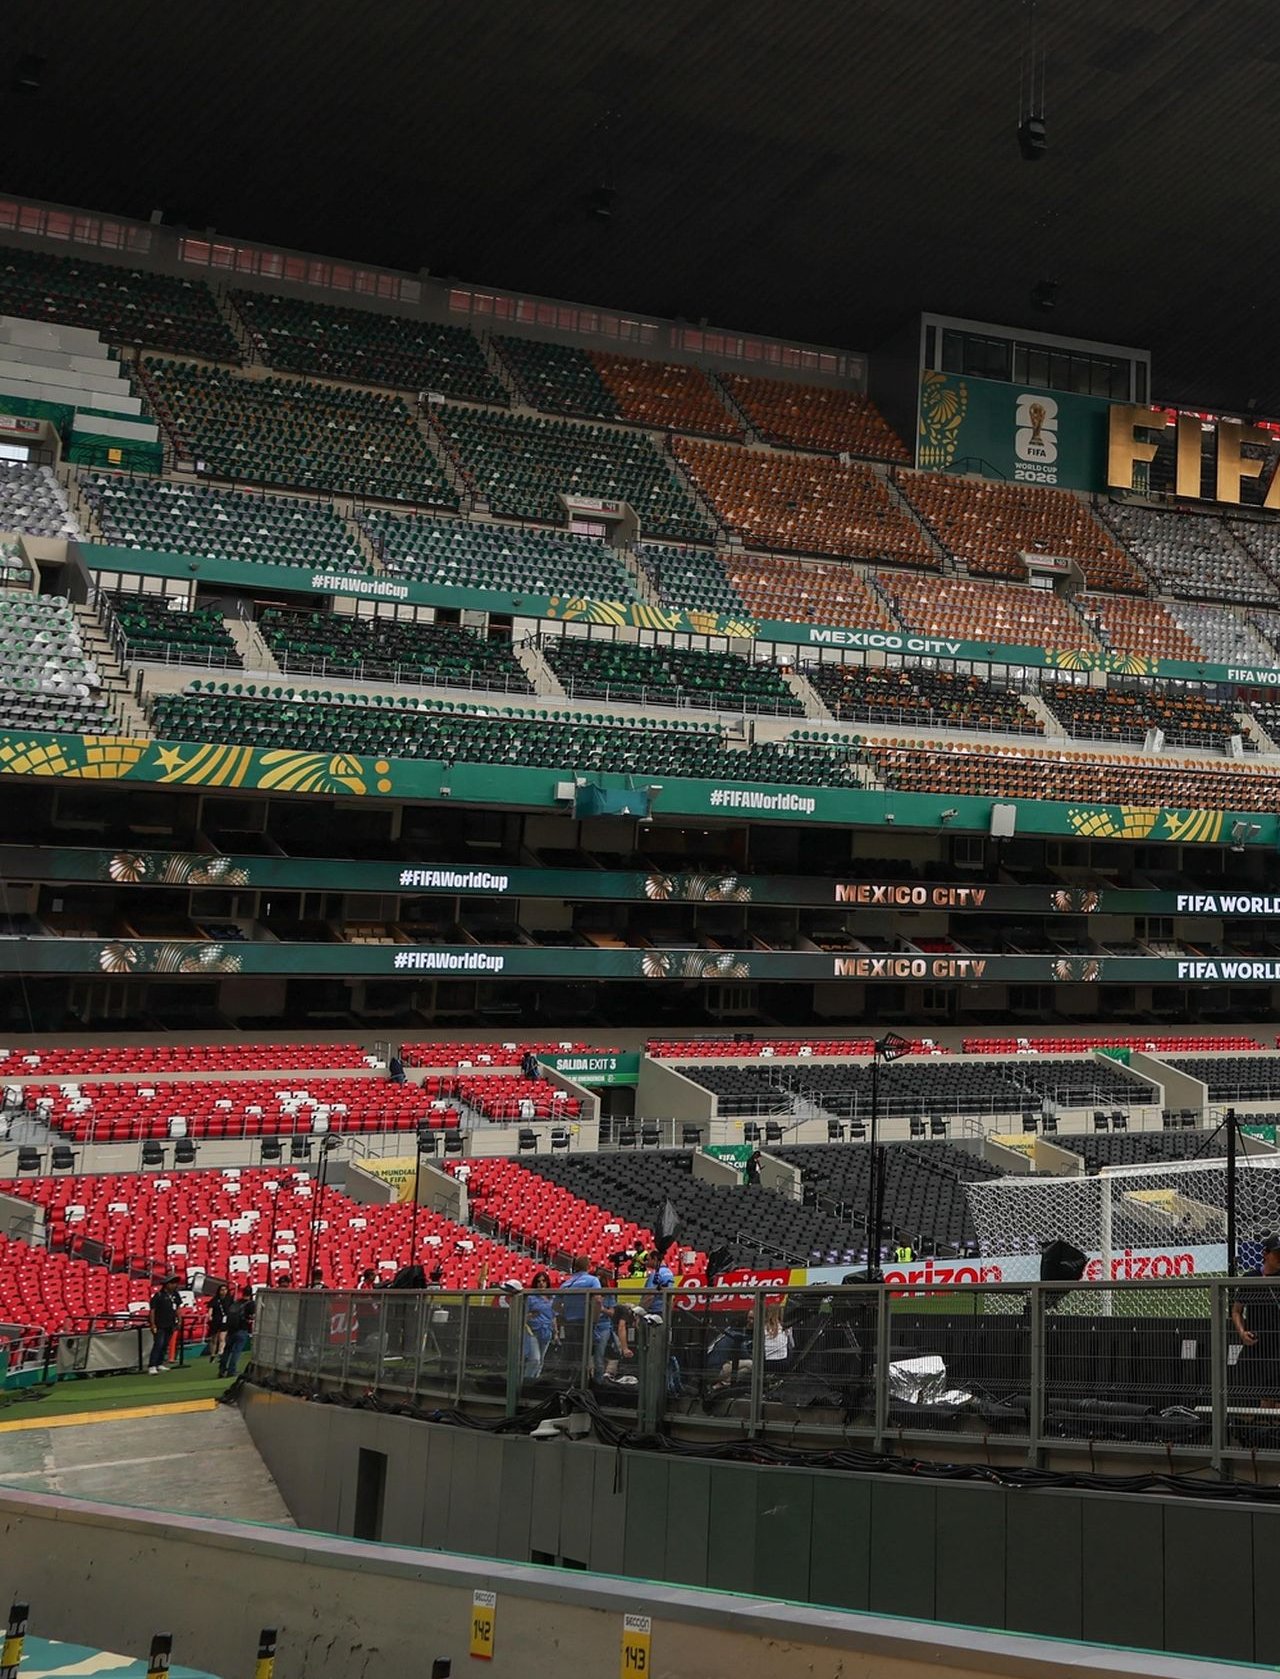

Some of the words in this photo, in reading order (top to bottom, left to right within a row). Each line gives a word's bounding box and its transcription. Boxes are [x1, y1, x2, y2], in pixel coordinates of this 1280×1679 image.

[1027, 448, 1047, 457] FIFA
[1015, 462, 1042, 471] WORLD
[1043, 465, 1057, 473] CUP
[1015, 470, 1057, 484] 2026
[312, 575, 408, 599] #FIFAWorldCup
[809, 629, 903, 648] MEXICO
[908, 637, 961, 655] CITY
[1228, 669, 1255, 681] FIFA
[711, 790, 816, 814] #FIFAWorldCup
[400, 870, 508, 891] #FIFAWorldCup
[835, 884, 927, 904] MEXICO
[933, 888, 986, 906] CITY
[1177, 895, 1217, 912] FIFA
[395, 952, 504, 972] #FIFAWorldCup
[834, 958, 927, 977] MEXICO
[933, 960, 986, 978] CITY
[1178, 962, 1218, 978] FIFA
[556, 1058, 588, 1070] SALIDA
[590, 1059, 608, 1070] EXIT
[610, 1058, 617, 1070] 3
[1086, 1248, 1194, 1280] erizon
[883, 1260, 1002, 1290] erizon
[474, 1619, 491, 1641] 142
[625, 1646, 645, 1670] 143
